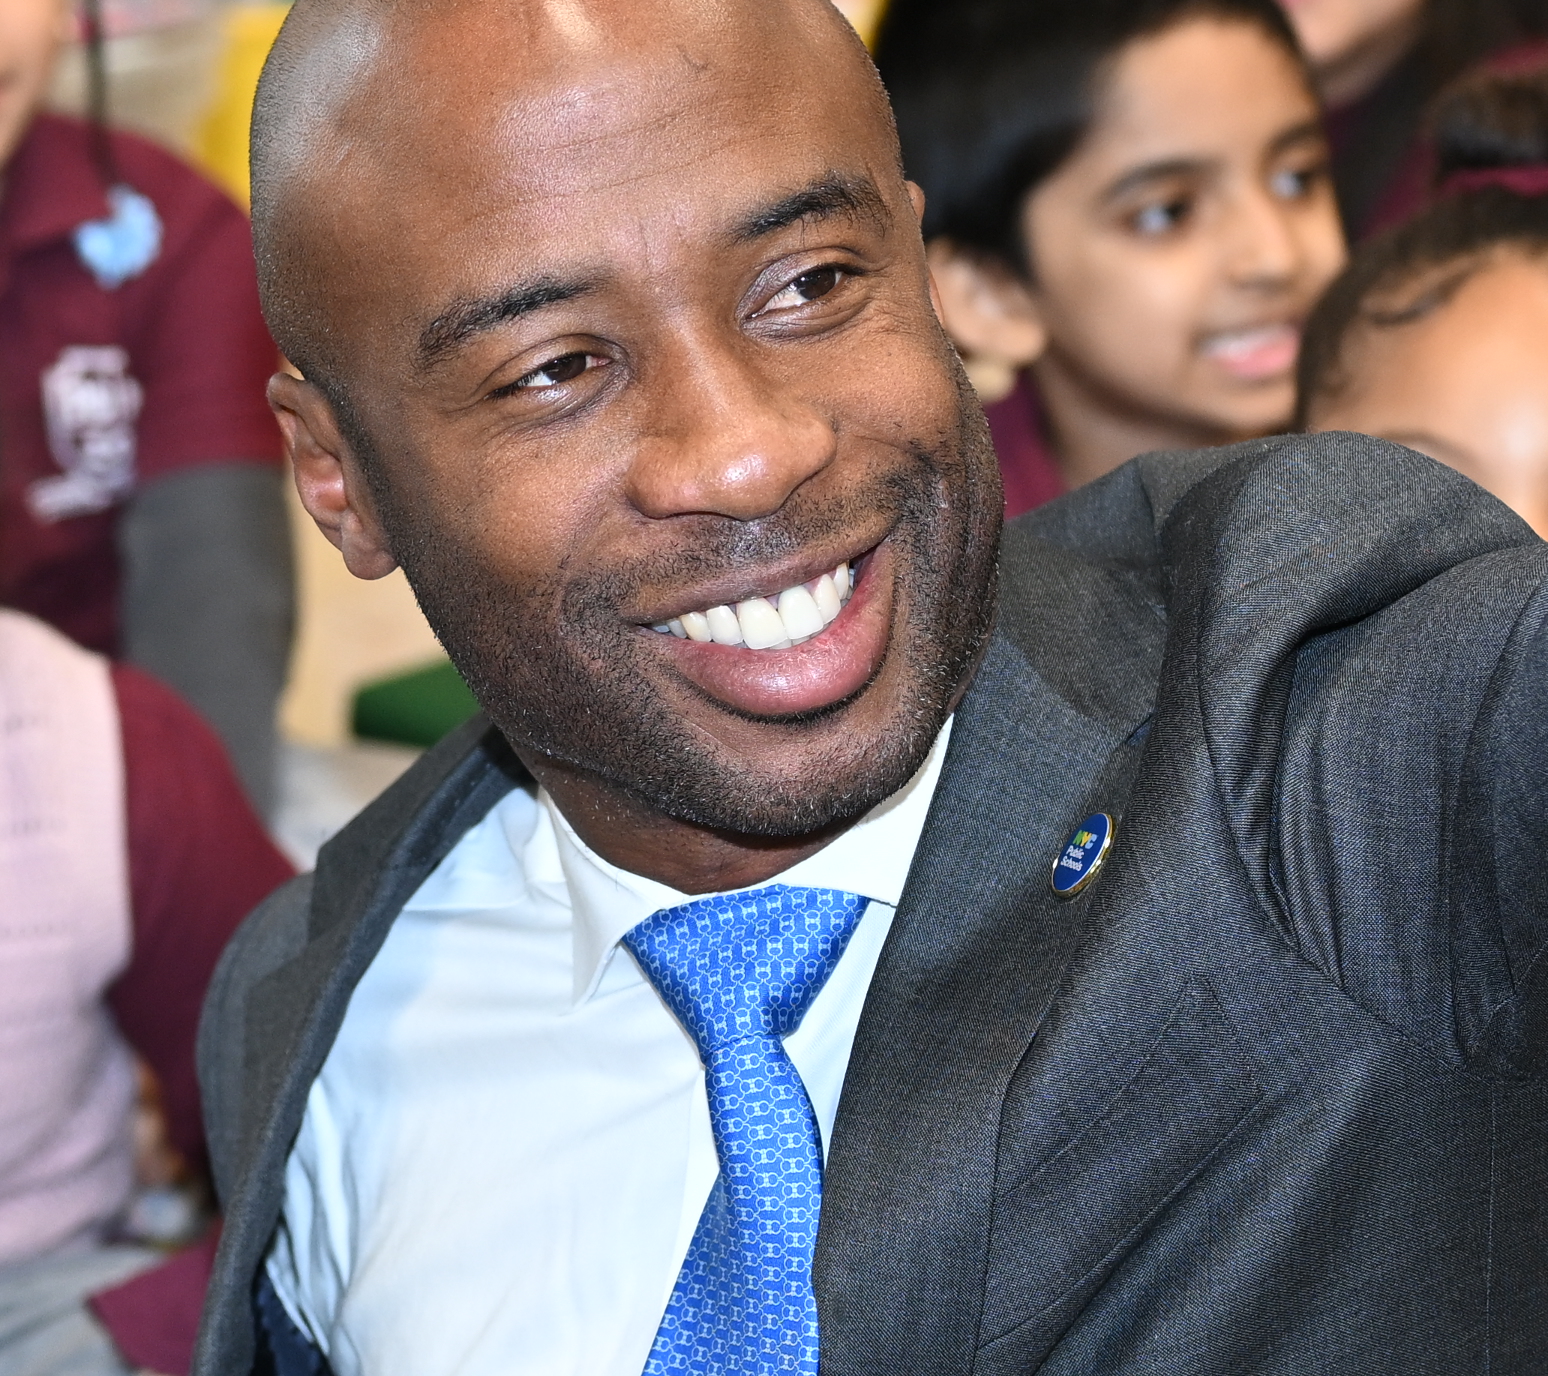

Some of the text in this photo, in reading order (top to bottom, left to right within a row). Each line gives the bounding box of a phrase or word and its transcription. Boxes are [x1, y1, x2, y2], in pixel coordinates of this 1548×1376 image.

[1072, 829, 1099, 850] NYC
[1065, 845, 1084, 860] Public
[1060, 855, 1083, 872] Schools
